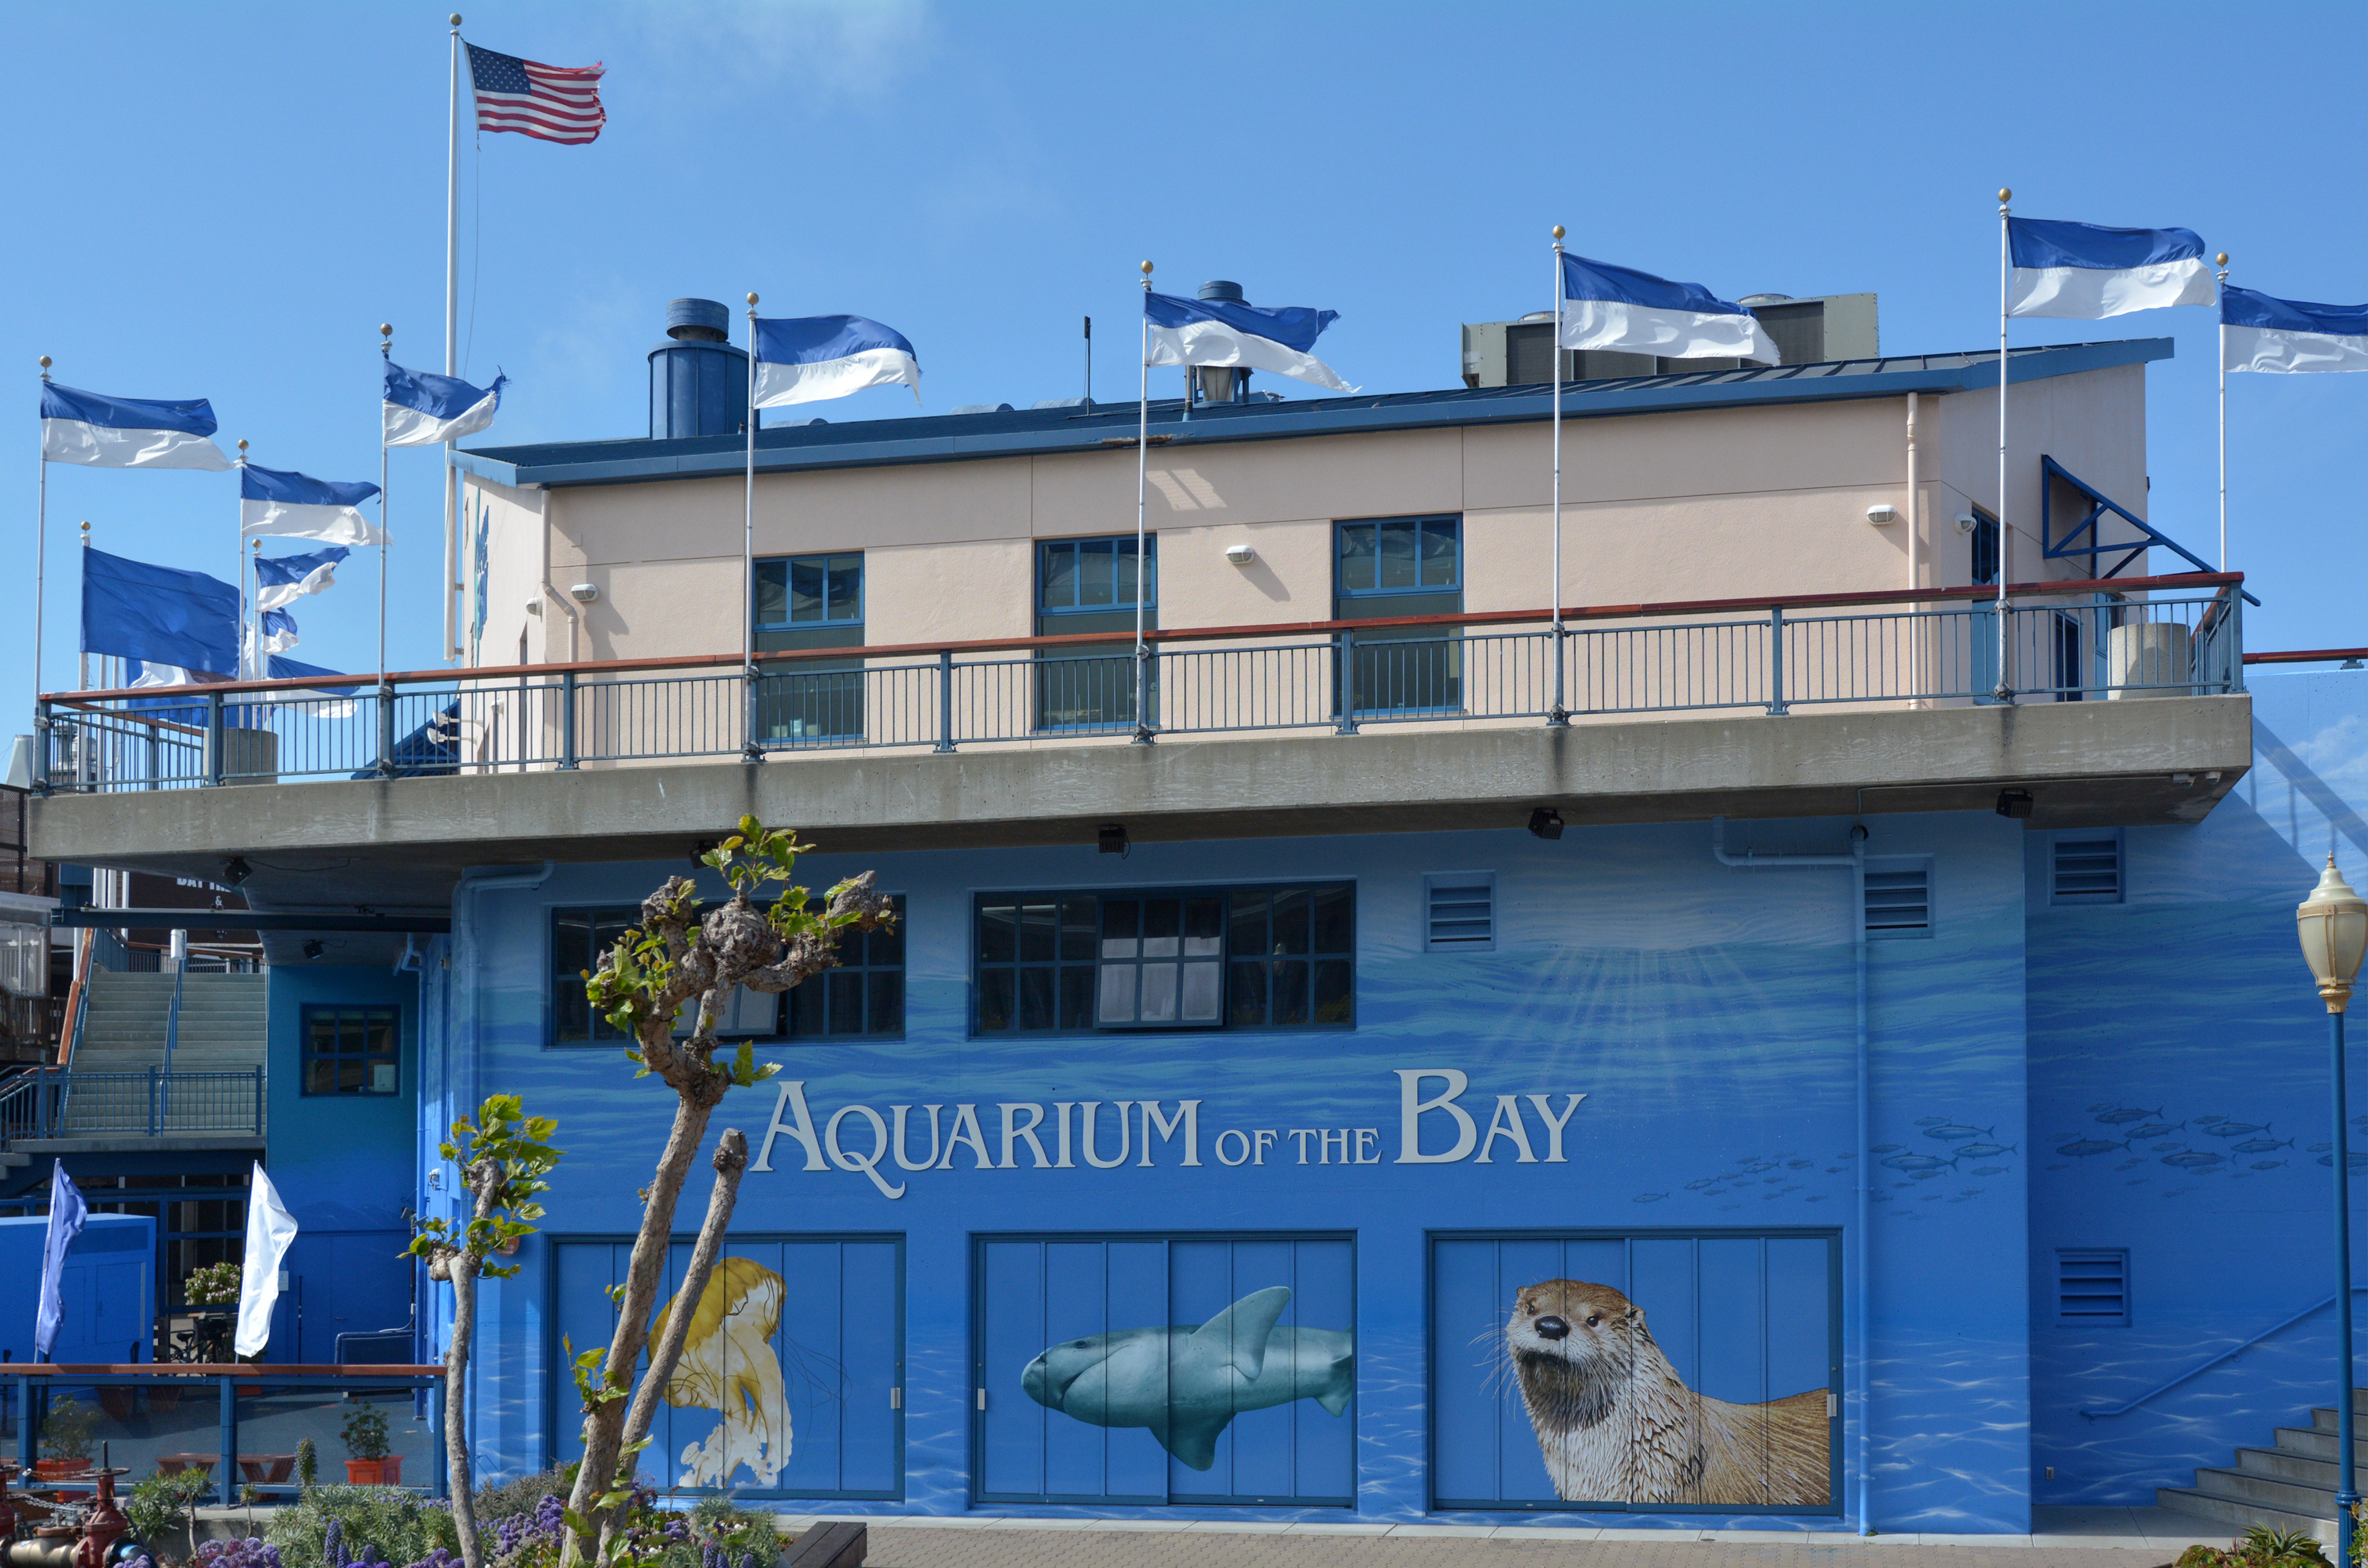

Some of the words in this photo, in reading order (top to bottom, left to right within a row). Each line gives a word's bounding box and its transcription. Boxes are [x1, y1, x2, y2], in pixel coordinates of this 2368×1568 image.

[215, 895, 223, 906] &
[749, 1081, 1202, 1199] AQUARIUM
[1215, 1130, 1278, 1166] OF
[1288, 1129, 1381, 1164] THE
[1393, 1068, 1587, 1163] BAY
